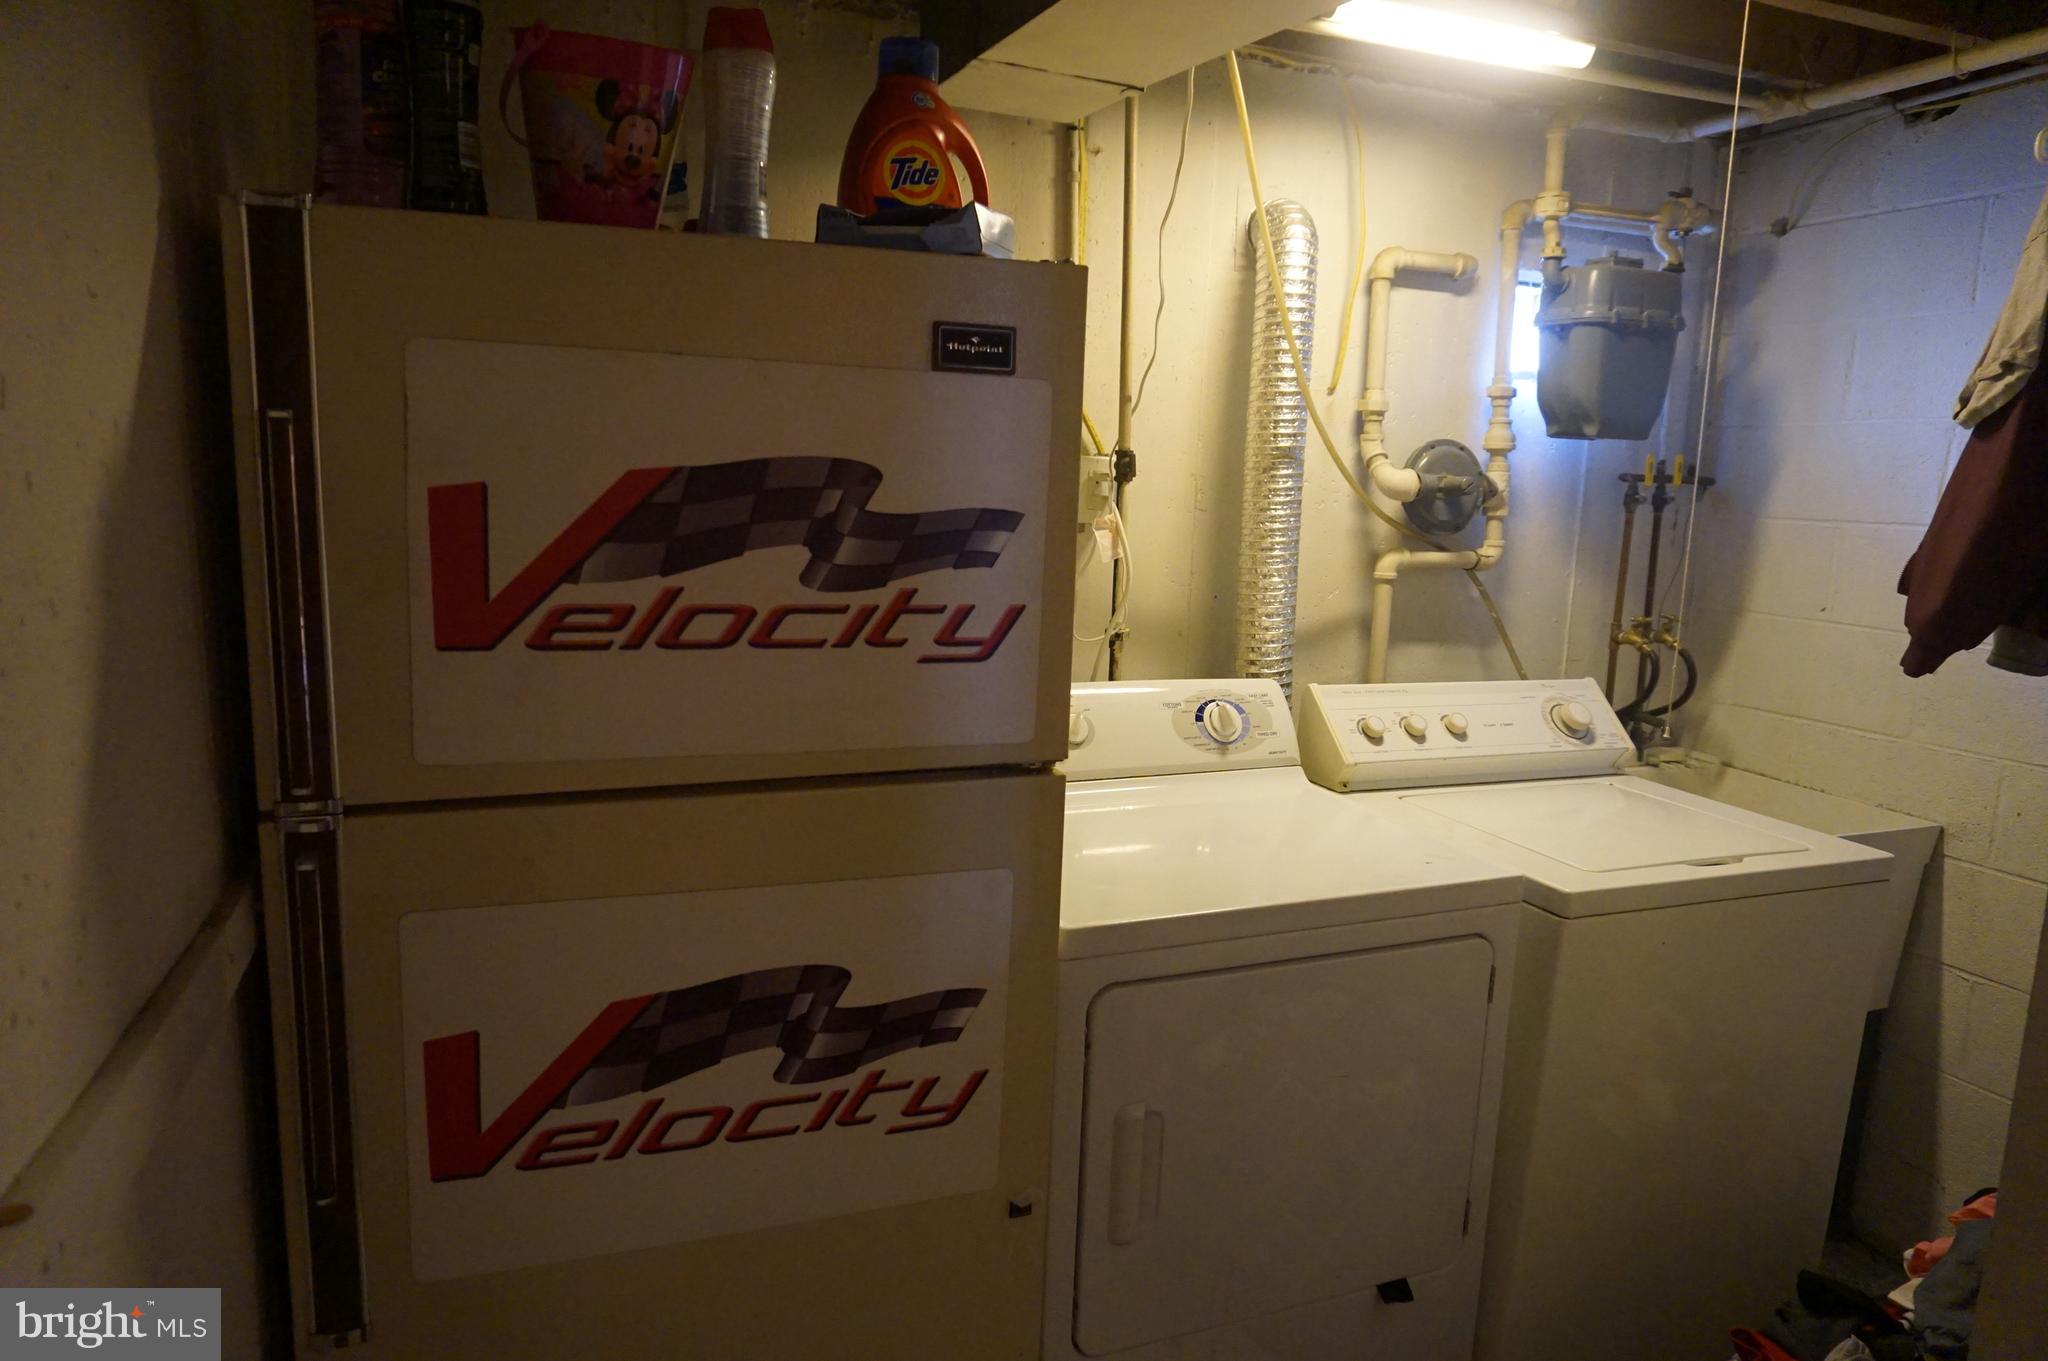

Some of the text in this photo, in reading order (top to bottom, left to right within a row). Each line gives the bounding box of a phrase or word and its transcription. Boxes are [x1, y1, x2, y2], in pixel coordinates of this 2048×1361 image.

[890, 157, 939, 190] Tide
[427, 466, 1027, 664] Velocity
[423, 993, 989, 1183] Velocity
